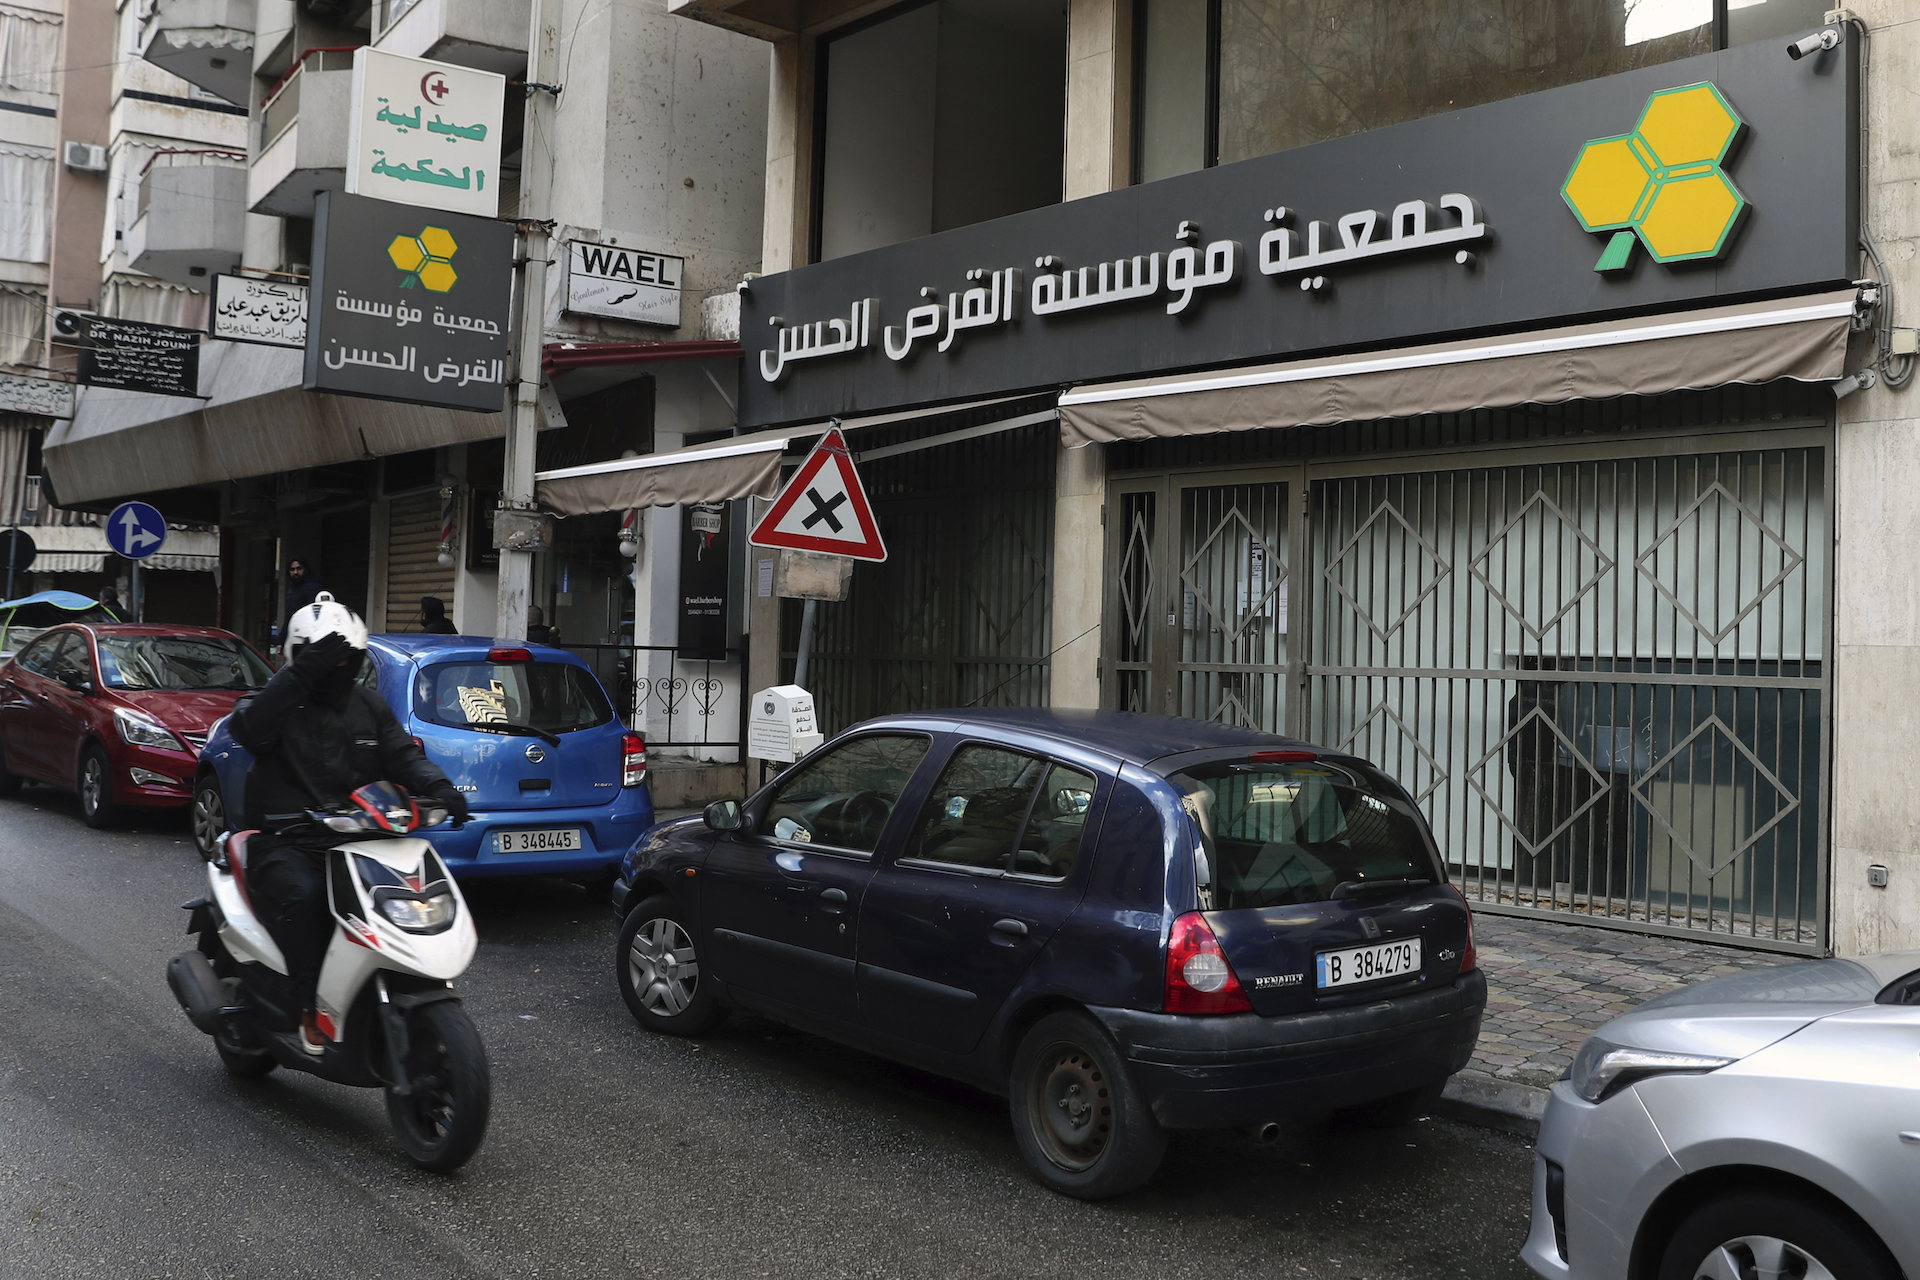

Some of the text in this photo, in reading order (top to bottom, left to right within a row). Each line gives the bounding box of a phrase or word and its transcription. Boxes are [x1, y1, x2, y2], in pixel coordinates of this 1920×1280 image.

[376, 97, 488, 143] صيدلية
[371, 149, 485, 192] الحكمة
[581, 246, 675, 287] WAEL
[570, 283, 679, 312] Gentlemen's Hair Style
[761, 193, 1486, 383] جمعية مؤسسة القرض الحسن
[335, 289, 423, 328] مؤسسة
[432, 305, 501, 341] جمعية
[324, 338, 504, 387] القرض الحسن
[692, 516, 720, 529] BARBER SHOP
[503, 831, 571, 850] B 348445
[1254, 973, 1304, 987] RENAULT
[1331, 944, 1411, 983] B 384279
